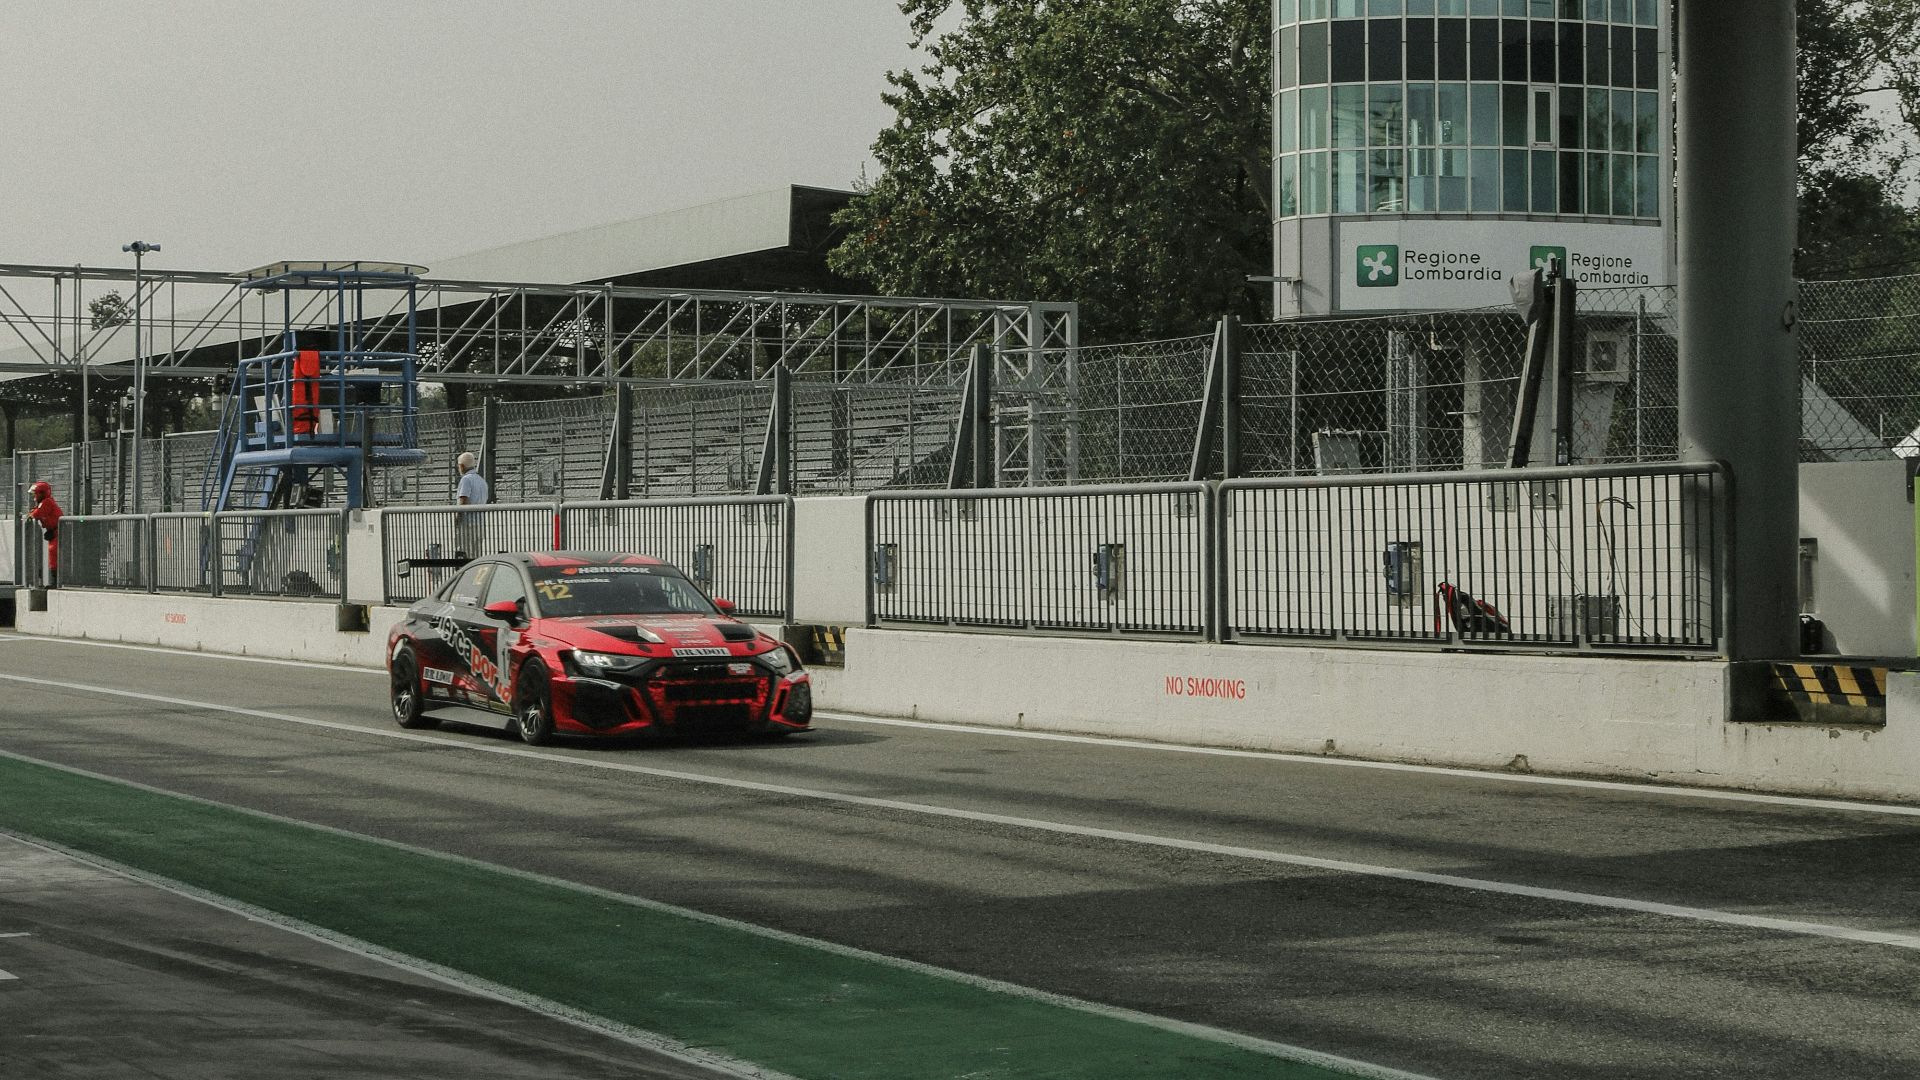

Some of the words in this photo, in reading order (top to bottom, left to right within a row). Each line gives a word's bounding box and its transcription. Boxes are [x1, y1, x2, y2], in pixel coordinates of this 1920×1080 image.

[1404, 250, 1480, 267] Regione
[1572, 253, 1633, 269] Regione
[1404, 267, 1502, 281] Lombardia
[1572, 269, 1649, 285] Lombardia
[539, 584, 573, 600] 12
[1166, 676, 1183, 695] NO
[1187, 677, 1246, 700] SMOKING
